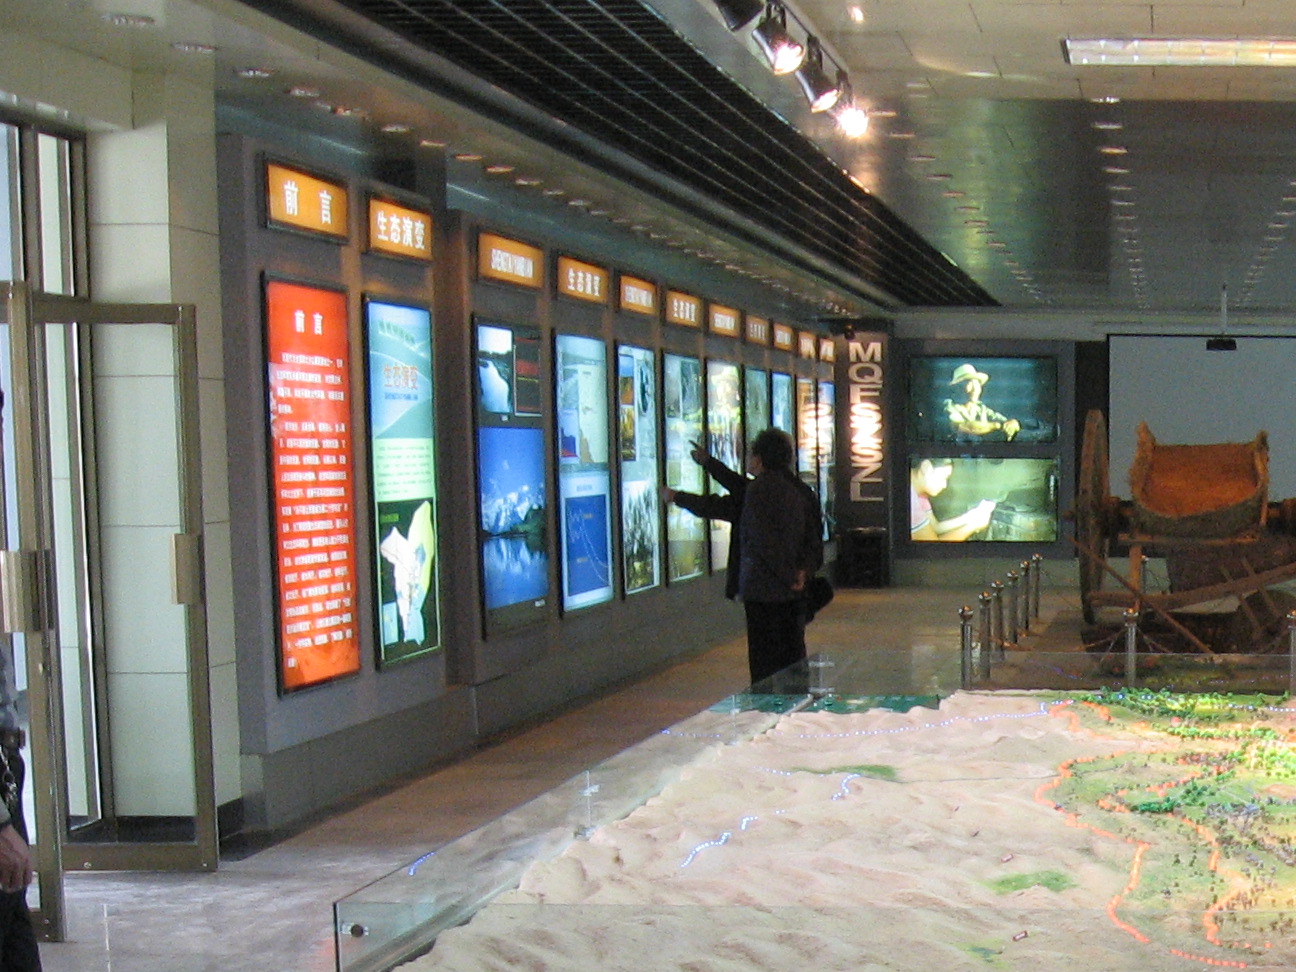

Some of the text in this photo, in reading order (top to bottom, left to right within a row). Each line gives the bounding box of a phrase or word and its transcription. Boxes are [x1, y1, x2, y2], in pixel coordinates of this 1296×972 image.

[284, 180, 332, 225] 前言
[375, 210, 425, 249] 生态演变
